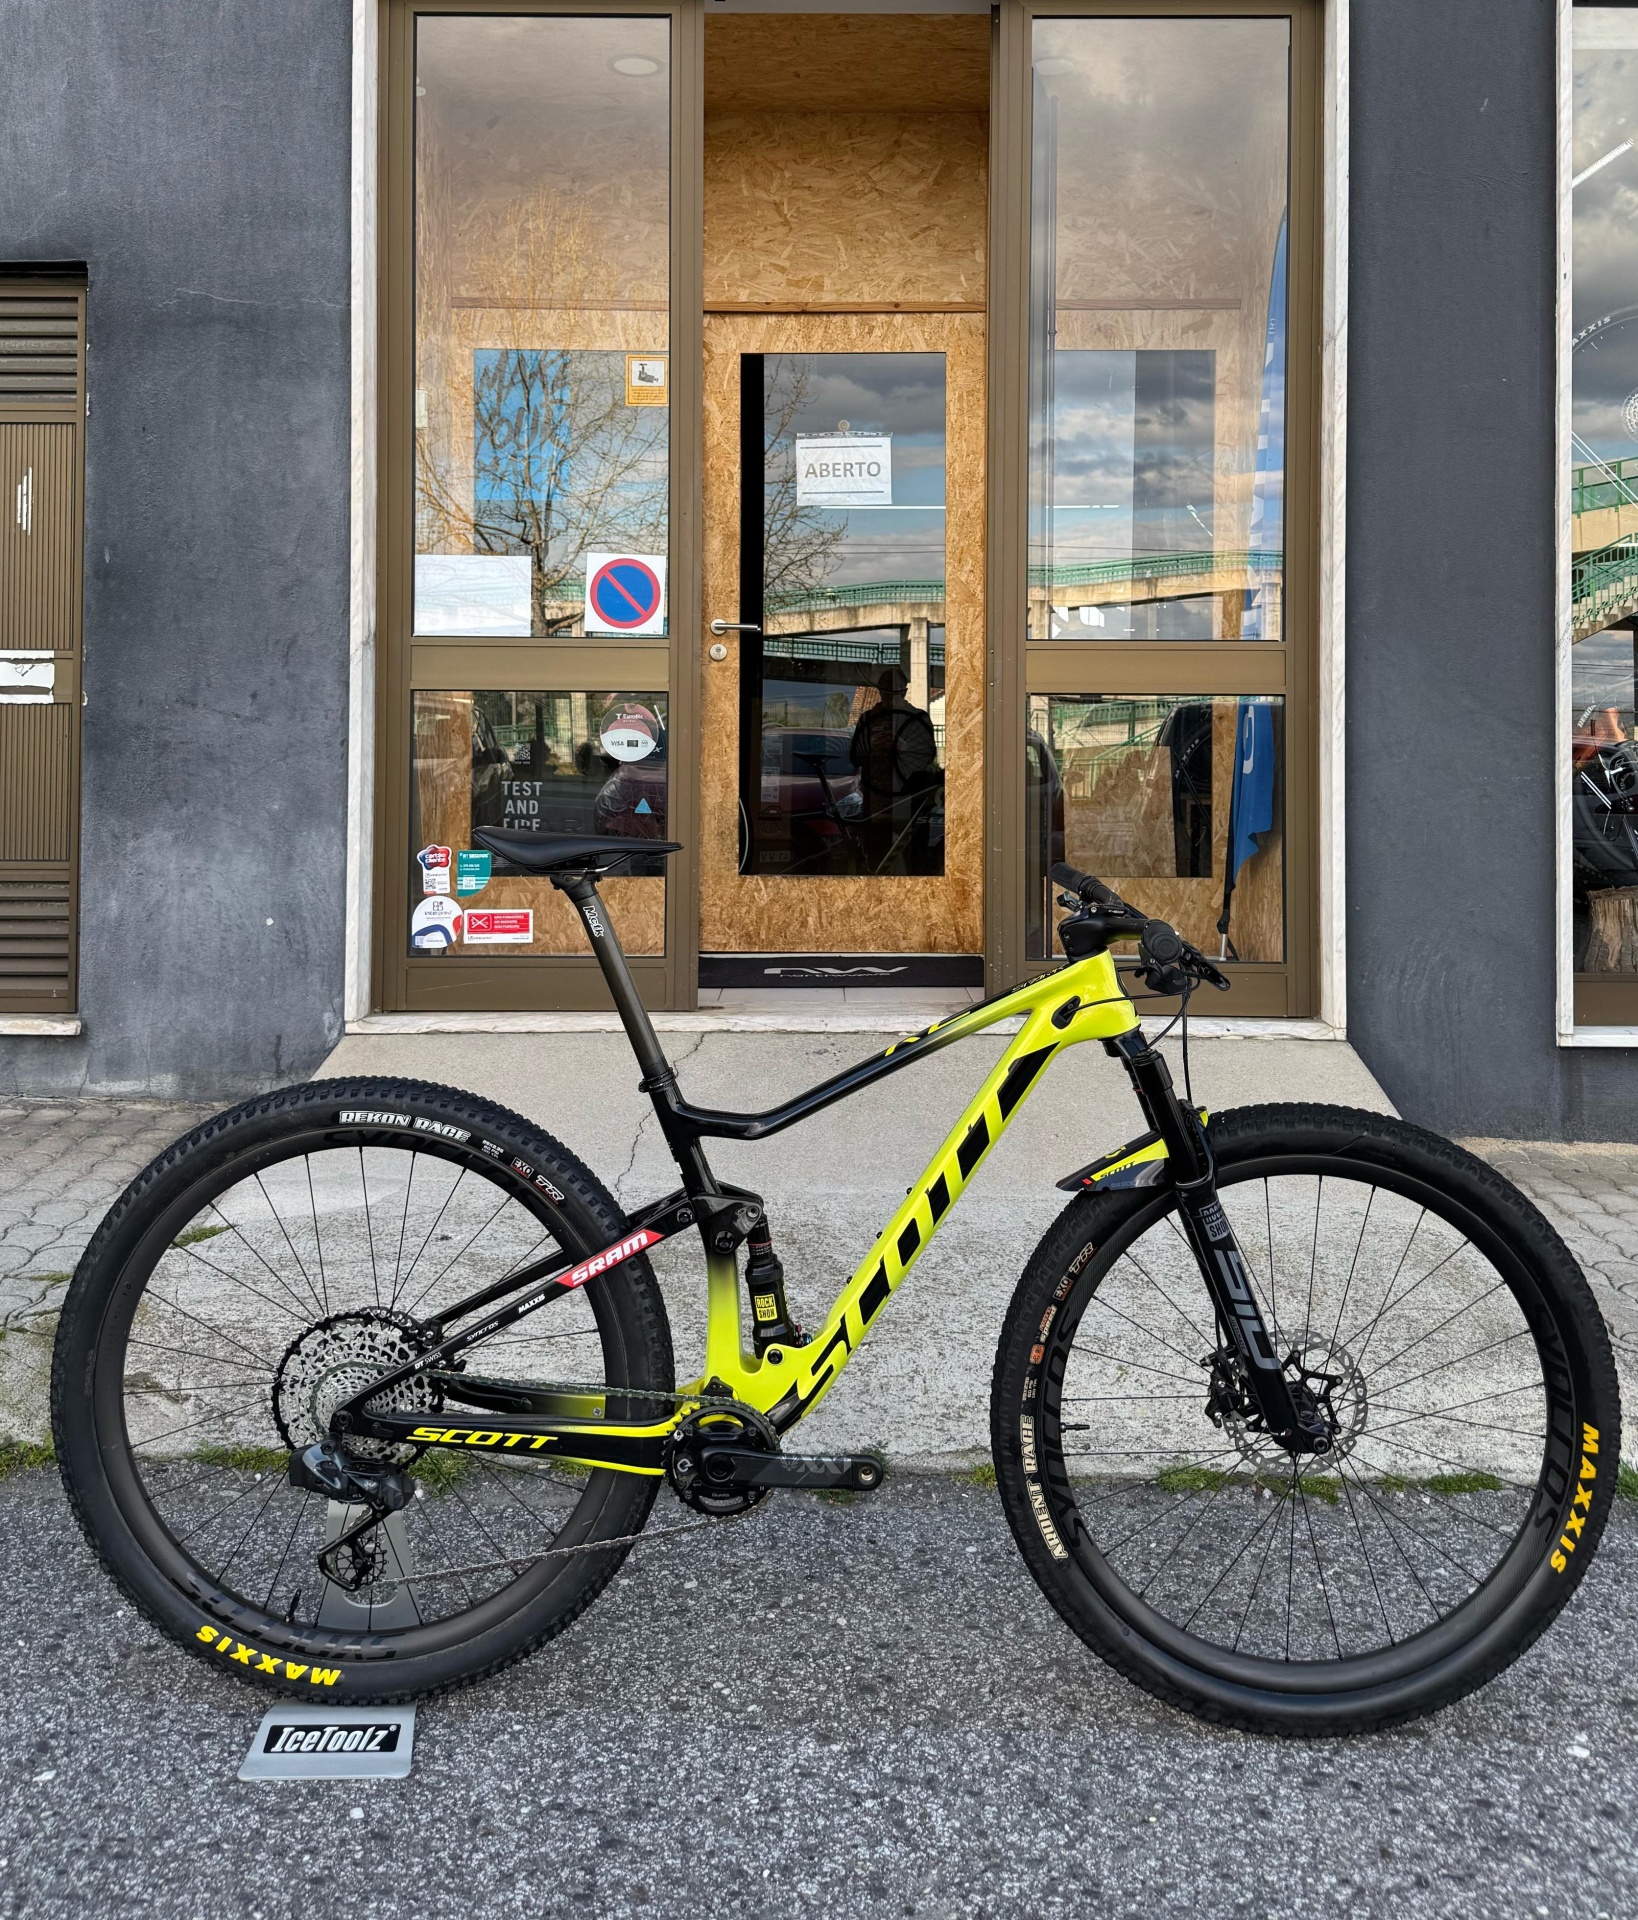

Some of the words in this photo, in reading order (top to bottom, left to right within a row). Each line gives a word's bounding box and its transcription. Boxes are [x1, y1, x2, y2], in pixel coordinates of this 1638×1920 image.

[805, 462, 881, 478] ABERTO
[501, 781, 543, 796] TEST
[505, 799, 539, 815] AND
[339, 1110, 411, 1127] REKON
[414, 1116, 472, 1143] RACE
[512, 1157, 533, 1177] EXO
[1100, 1161, 1136, 1179] SCOTT
[571, 1231, 649, 1286] SRAM
[1053, 1275, 1074, 1300] EXO
[518, 1293, 546, 1314] MAXXIS
[756, 1296, 774, 1308] ROCK
[414, 1359, 424, 1370] DT
[424, 1351, 443, 1366] SWISS
[406, 1427, 558, 1449] SCOTT
[1020, 1414, 1038, 1475] RACE
[1551, 1421, 1600, 1574] MAXXIS
[1026, 1480, 1068, 1560] ARDENT
[195, 1625, 342, 1686] MAXXIS
